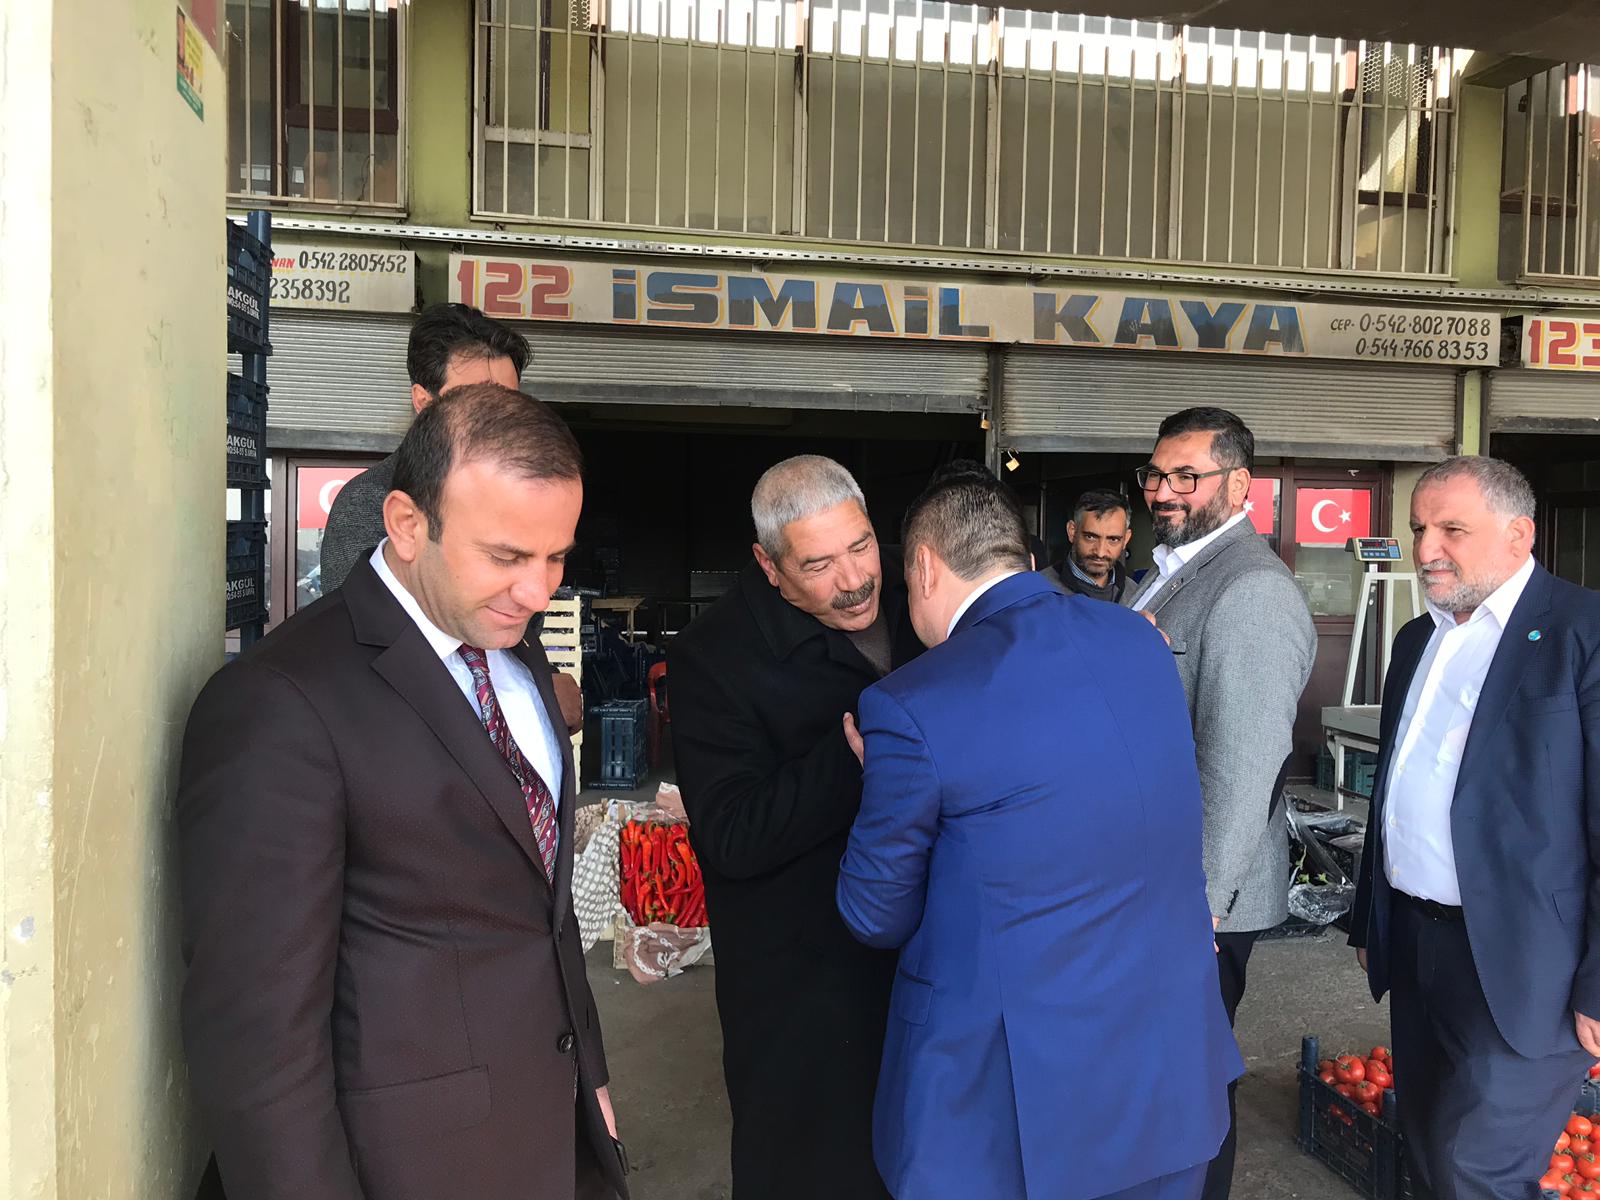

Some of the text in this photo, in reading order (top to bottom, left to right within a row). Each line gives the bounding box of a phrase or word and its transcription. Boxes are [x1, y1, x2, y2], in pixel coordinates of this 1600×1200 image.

[227, 286, 260, 312] AKGÜL
[457, 259, 574, 319] 122
[1033, 292, 1309, 355] KAYA
[1528, 320, 1600, 367] 123
